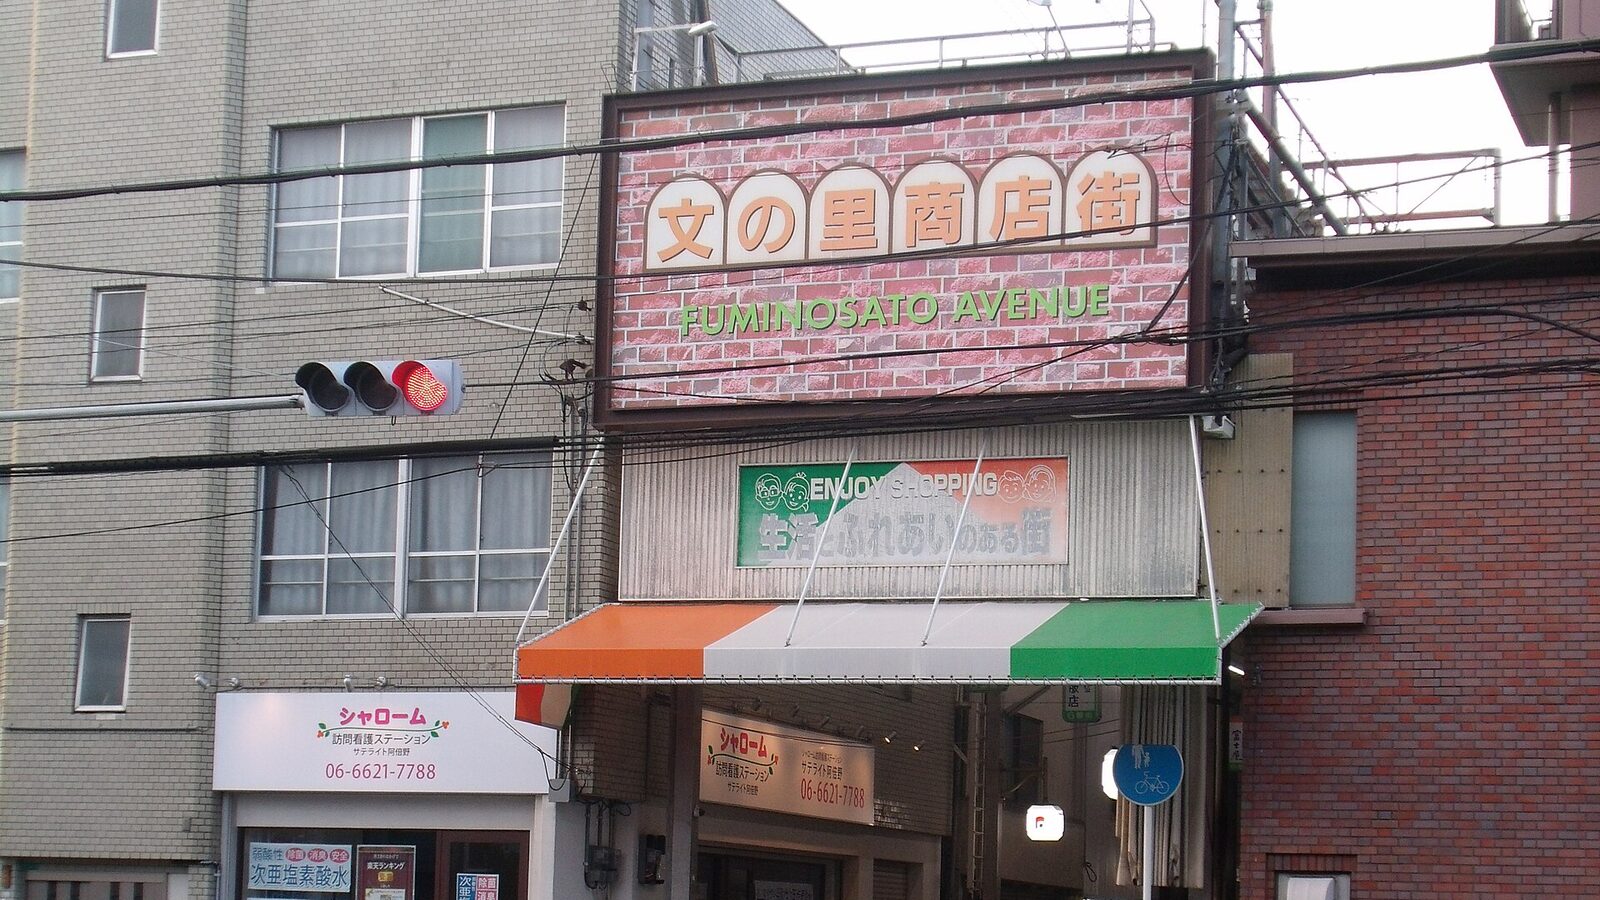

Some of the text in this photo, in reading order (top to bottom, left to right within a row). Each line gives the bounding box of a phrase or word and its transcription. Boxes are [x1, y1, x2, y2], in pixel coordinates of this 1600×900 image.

[657, 171, 1141, 264] 文の里商店街
[680, 284, 1111, 337] FUMINOSATO AVENUE
[810, 472, 999, 501] ENJOY SHOPPING
[339, 707, 427, 726] シャローム
[332, 733, 431, 746] 訪問看護ステーション
[720, 727, 768, 758] シャローム
[353, 748, 411, 757] サテライト阿倍野
[325, 763, 436, 780] 06-6621-7788
[715, 761, 770, 783] 訪問看護ステーション
[801, 778, 865, 809] 06-6621-7788
[331, 851, 348, 861] 安全
[250, 863, 348, 887] 次亜塩素酸水
